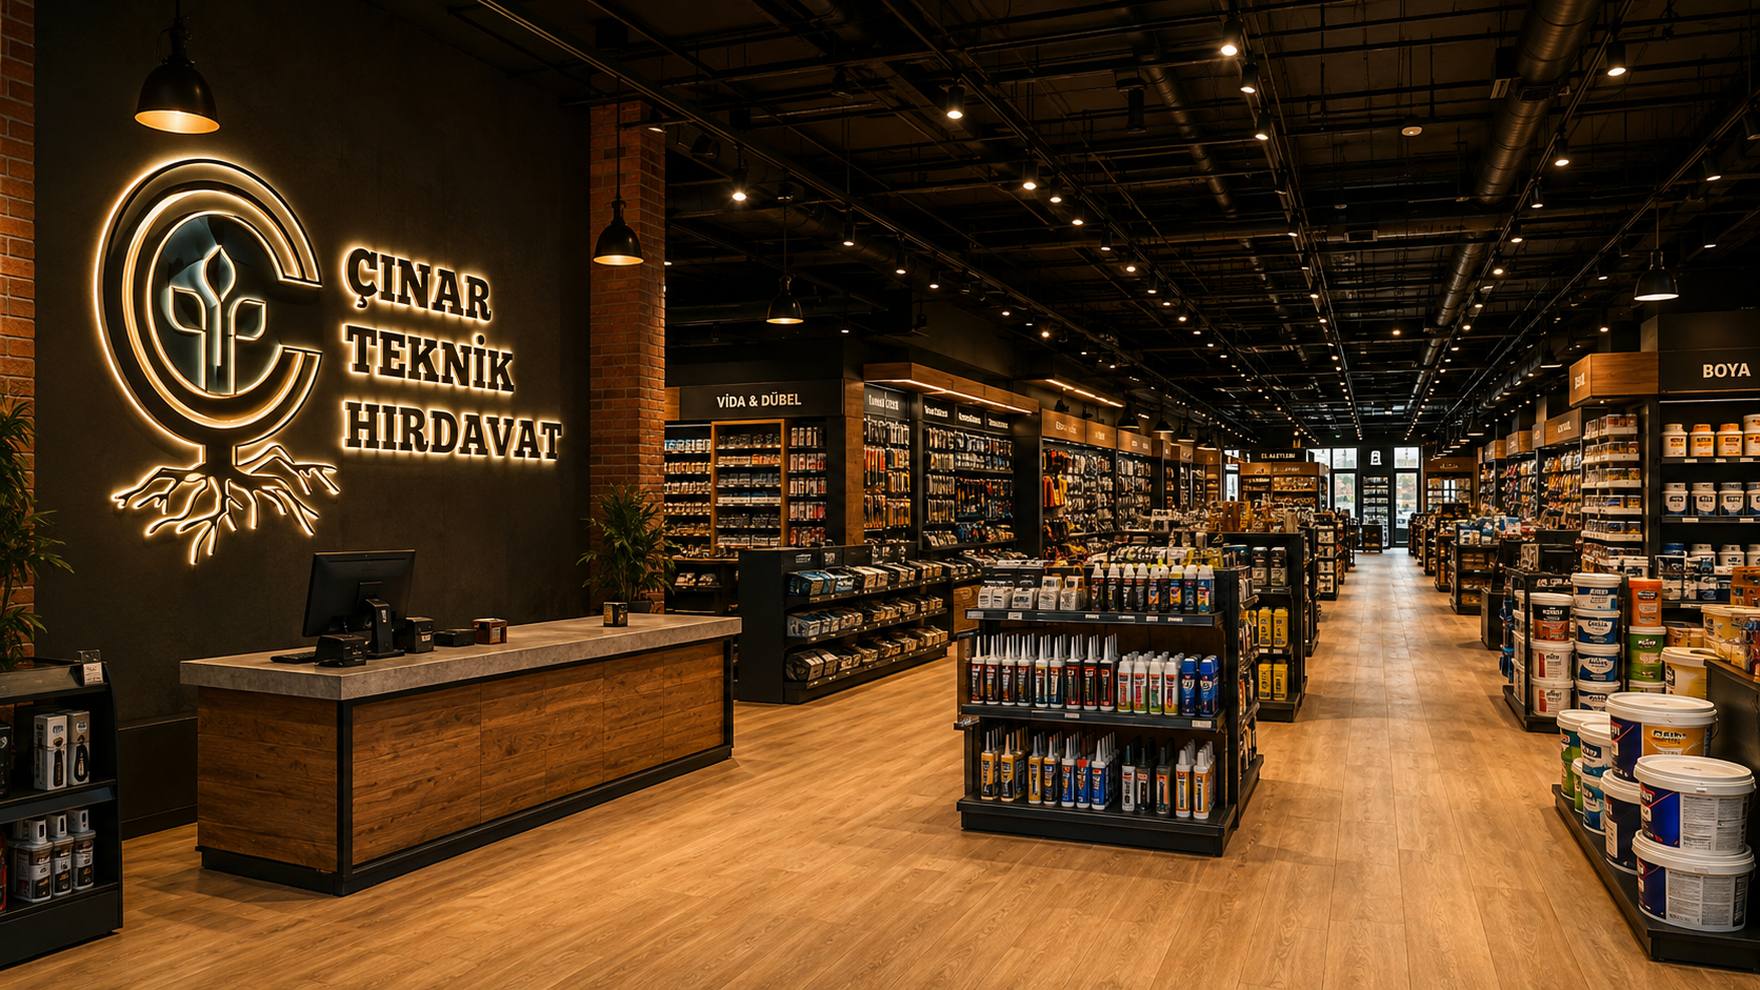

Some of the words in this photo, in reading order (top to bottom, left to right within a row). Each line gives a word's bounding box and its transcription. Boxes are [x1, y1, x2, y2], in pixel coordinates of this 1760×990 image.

[347, 247, 492, 322] ÇINAR
[344, 324, 515, 393] TEKNİK
[1702, 362, 1752, 379] BOYA
[716, 393, 746, 408] VİDA
[748, 394, 758, 407] &
[761, 391, 802, 407] DÜBEL
[344, 401, 563, 461] HIRDAVAT
